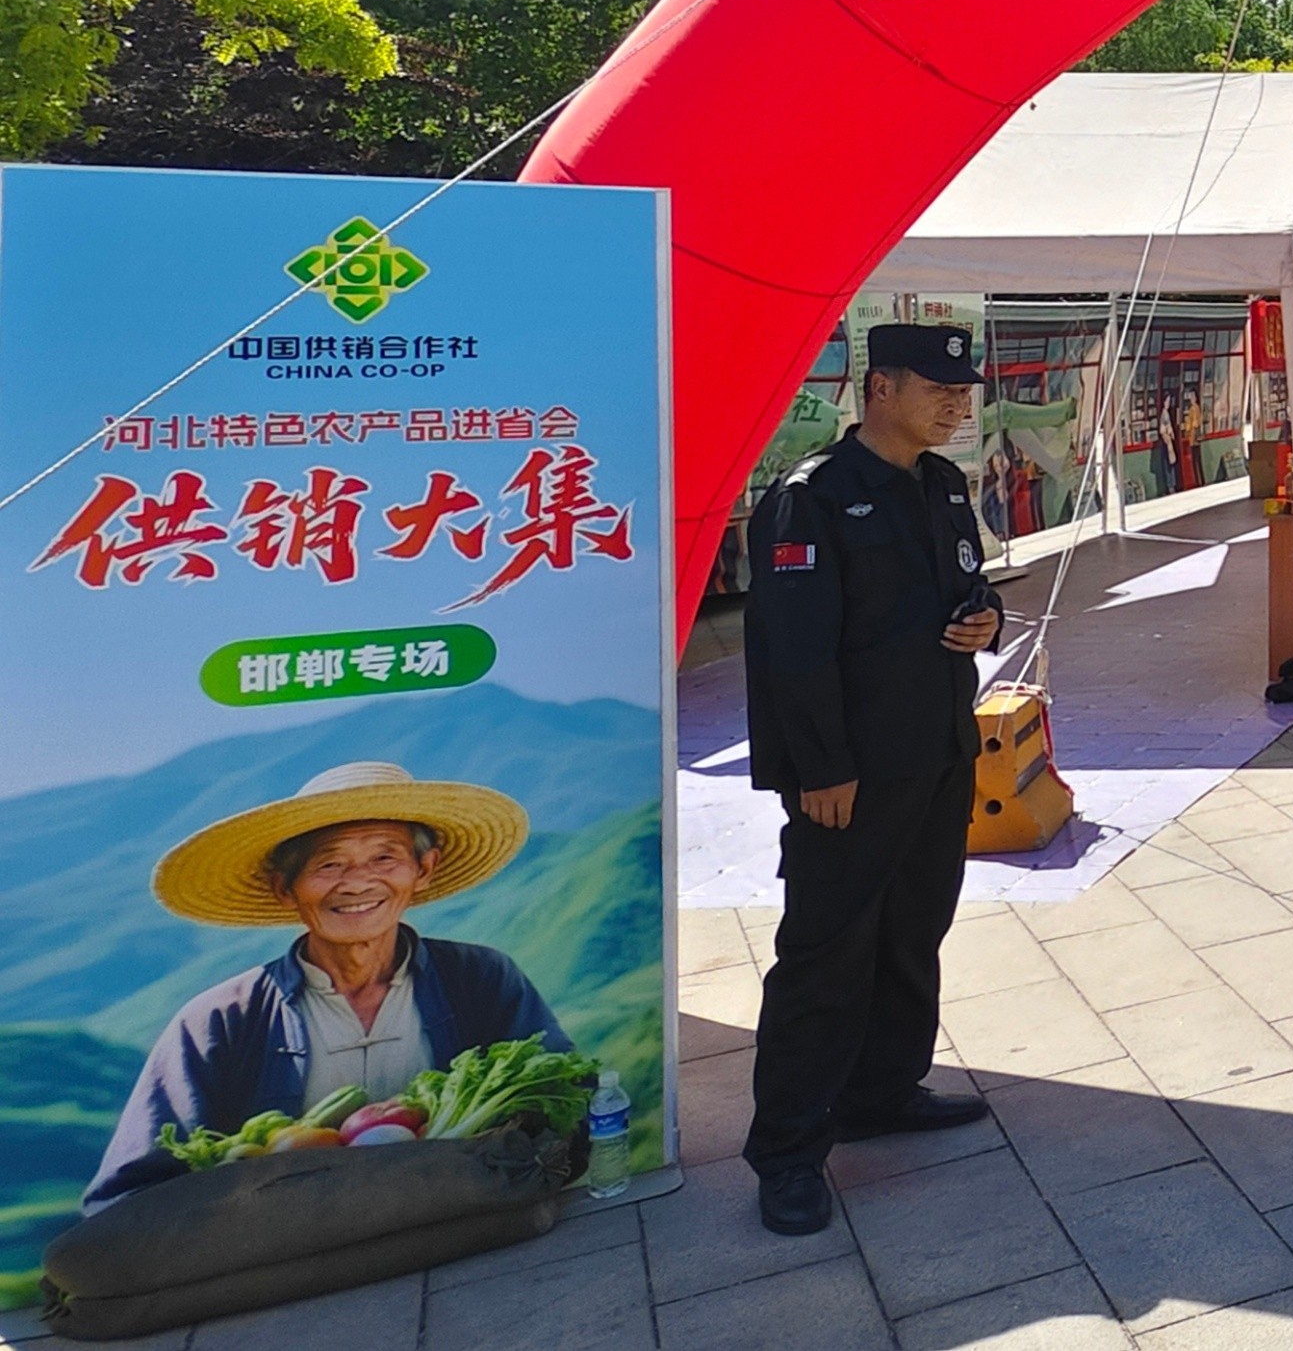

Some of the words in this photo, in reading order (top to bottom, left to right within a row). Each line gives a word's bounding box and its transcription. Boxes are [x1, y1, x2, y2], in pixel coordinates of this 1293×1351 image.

[228, 335, 478, 362] 中国供销合作社
[266, 364, 352, 380] CHINA
[361, 362, 445, 379] CO-OP
[103, 406, 579, 452] 河北特色农产品进省会
[27, 446, 636, 615] 供销大集
[237, 639, 450, 693] 邯郸专场
